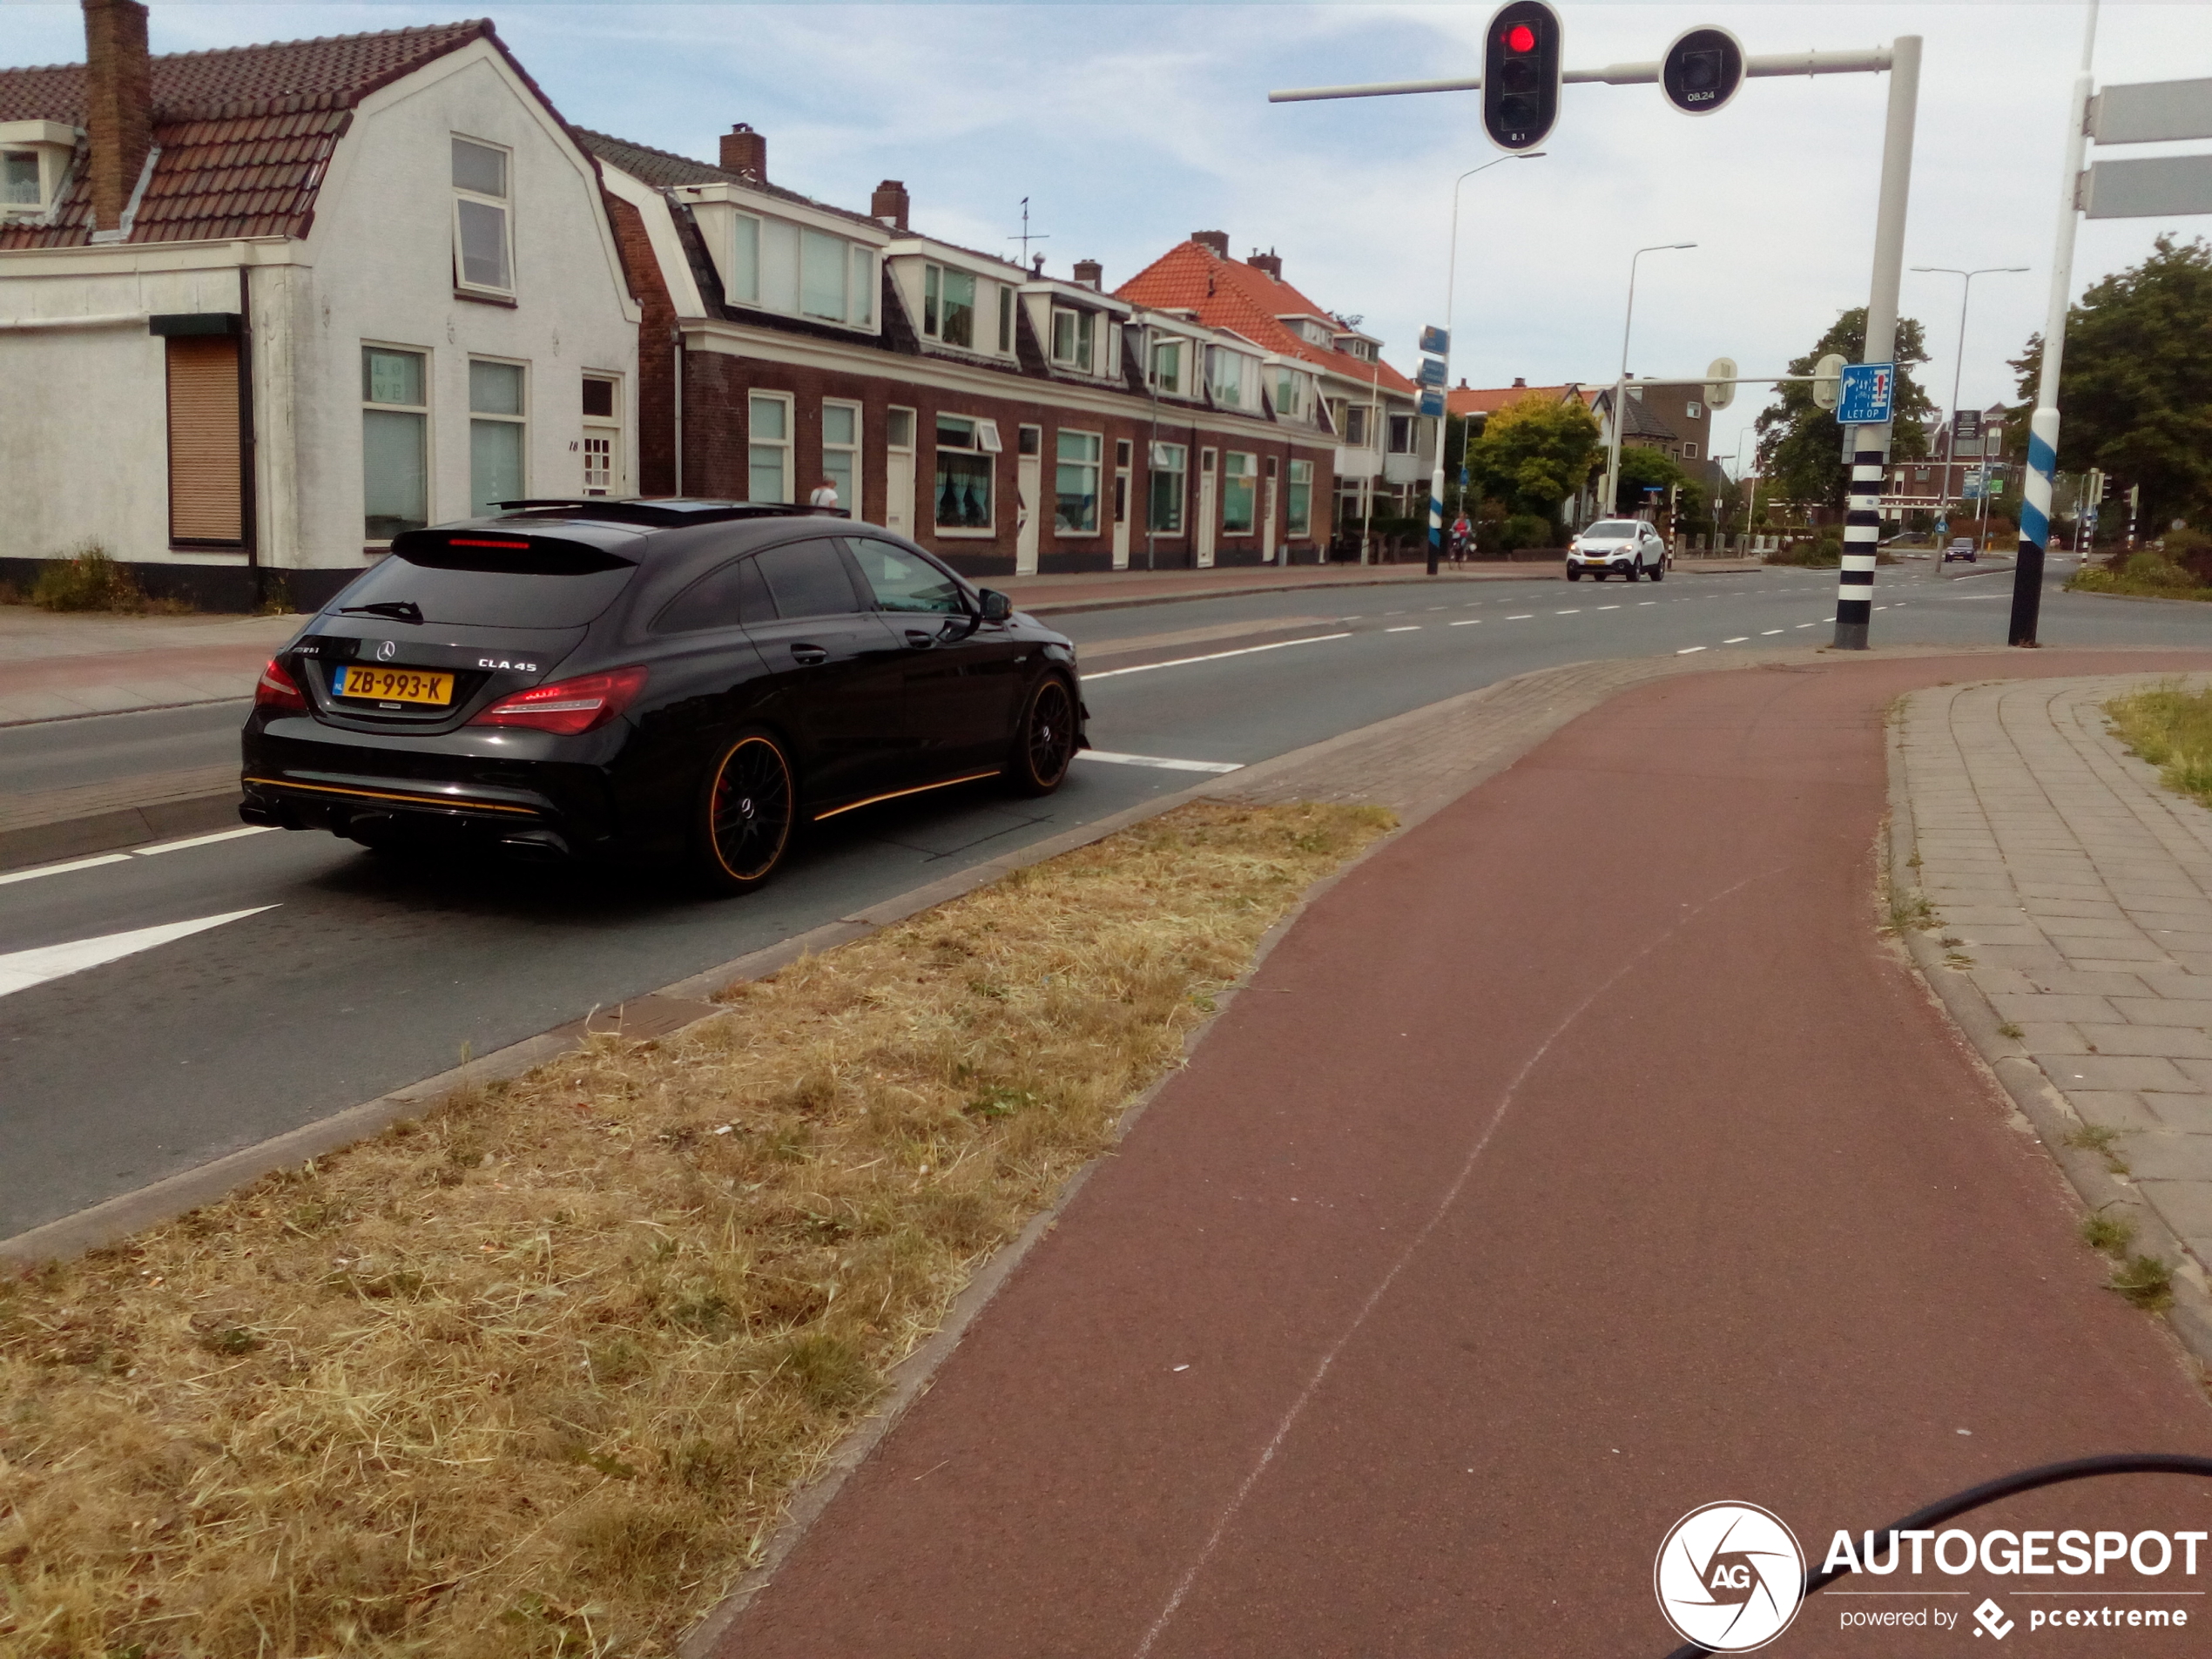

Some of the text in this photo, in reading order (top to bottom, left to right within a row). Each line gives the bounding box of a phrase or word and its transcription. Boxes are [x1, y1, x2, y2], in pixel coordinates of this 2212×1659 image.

[1687, 91, 1716, 102] 08.24
[1847, 408, 1879, 419] LET OP
[569, 441, 579, 452] 18
[478, 658, 537, 672] CLA 45
[347, 670, 442, 700] ZB-993-K
